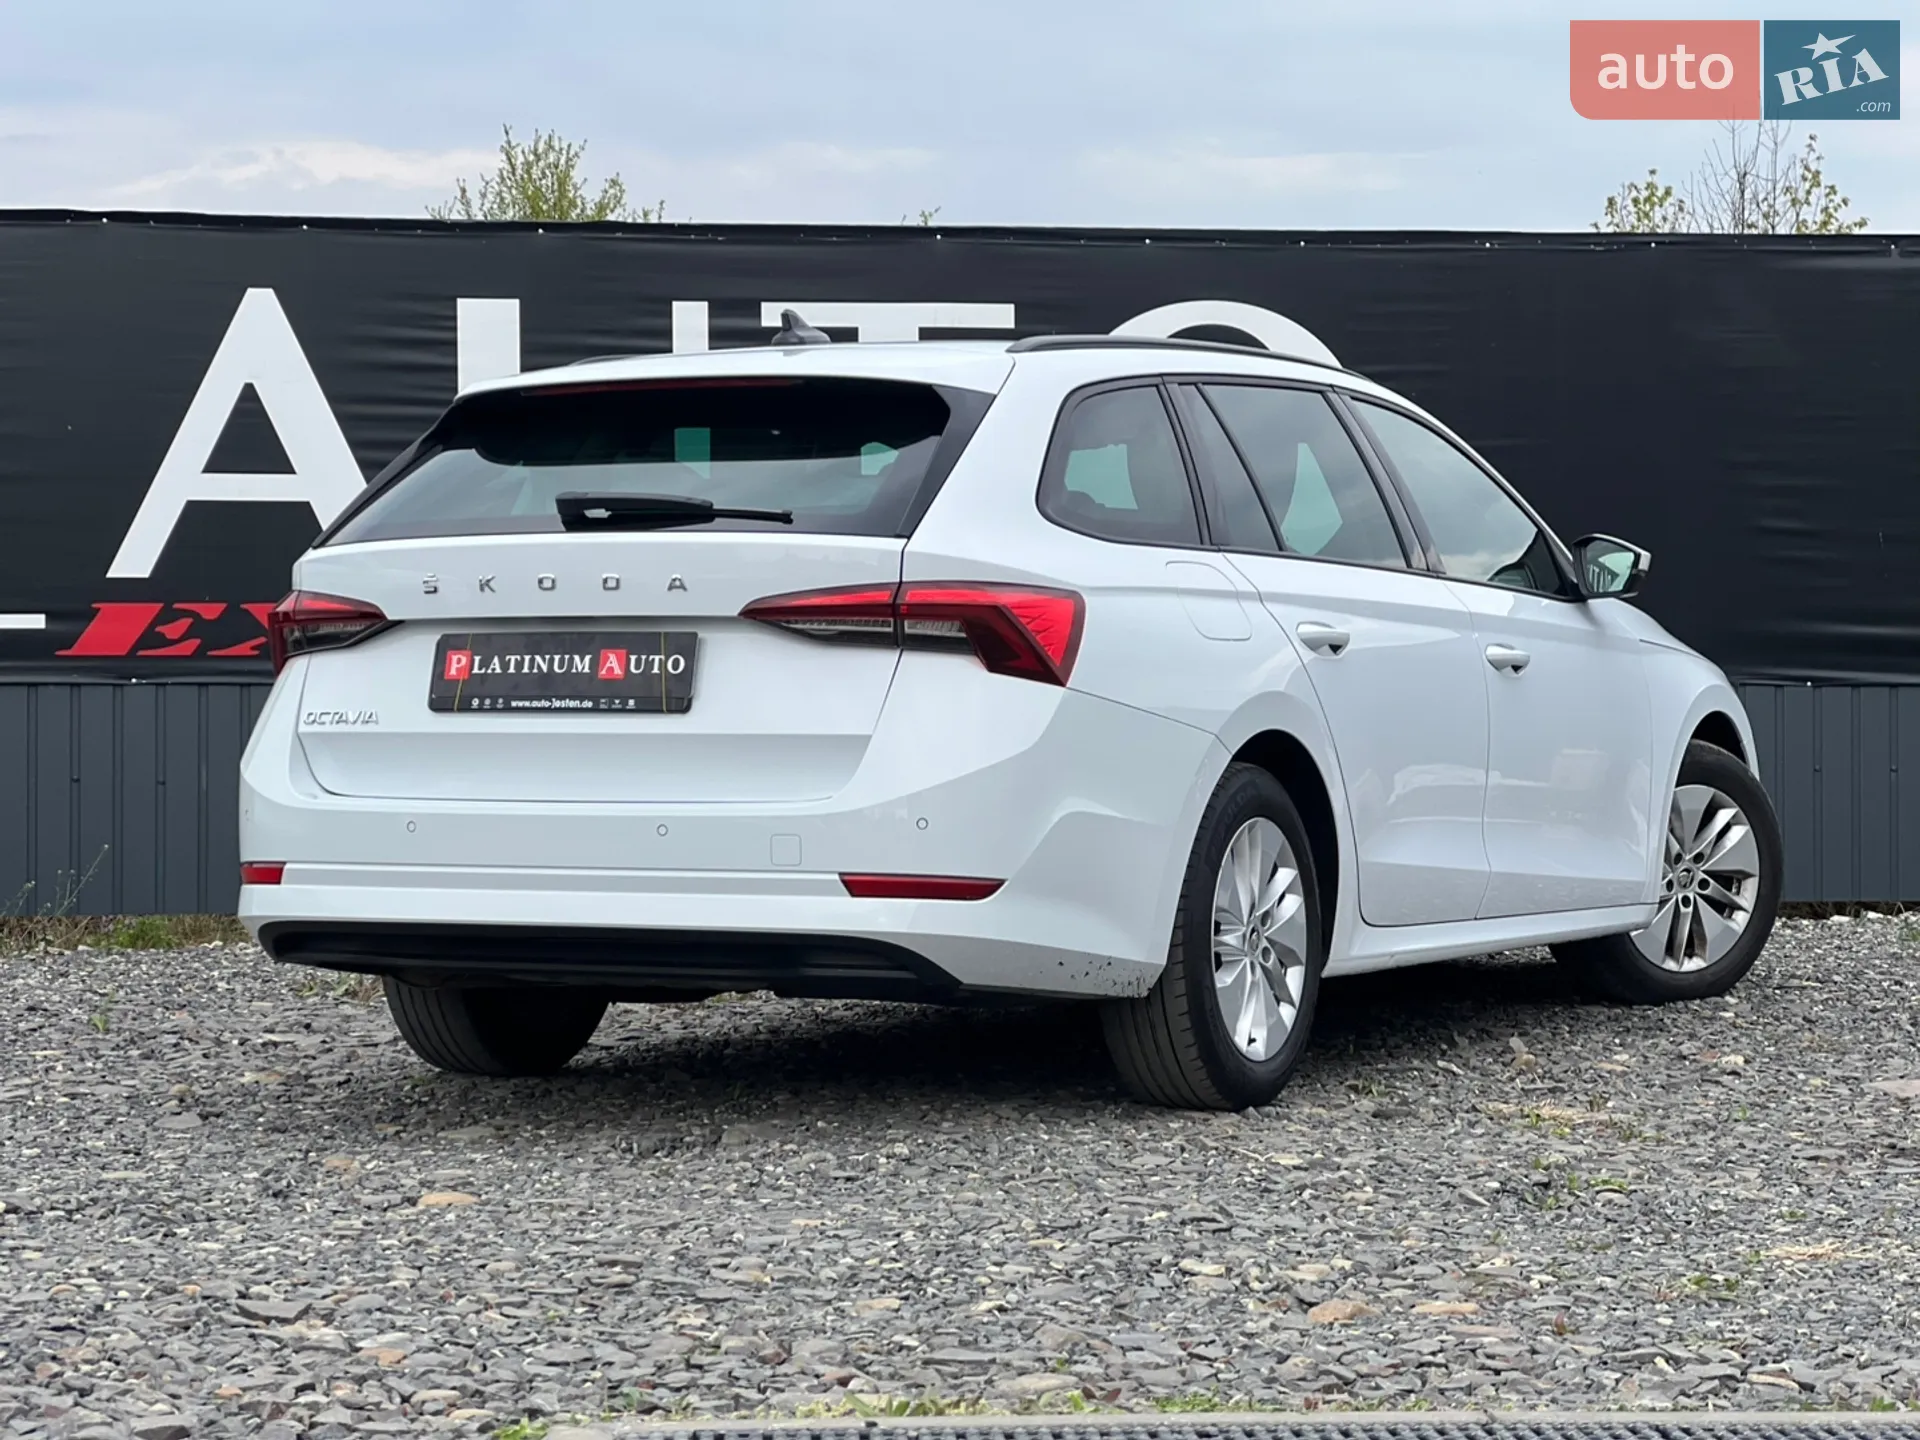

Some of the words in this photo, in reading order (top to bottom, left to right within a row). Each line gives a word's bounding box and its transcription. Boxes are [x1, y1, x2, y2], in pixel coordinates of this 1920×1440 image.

[448, 653, 592, 677] PLATINUM
[601, 652, 686, 675] AUTO
[303, 710, 379, 725] OCTAVIA
